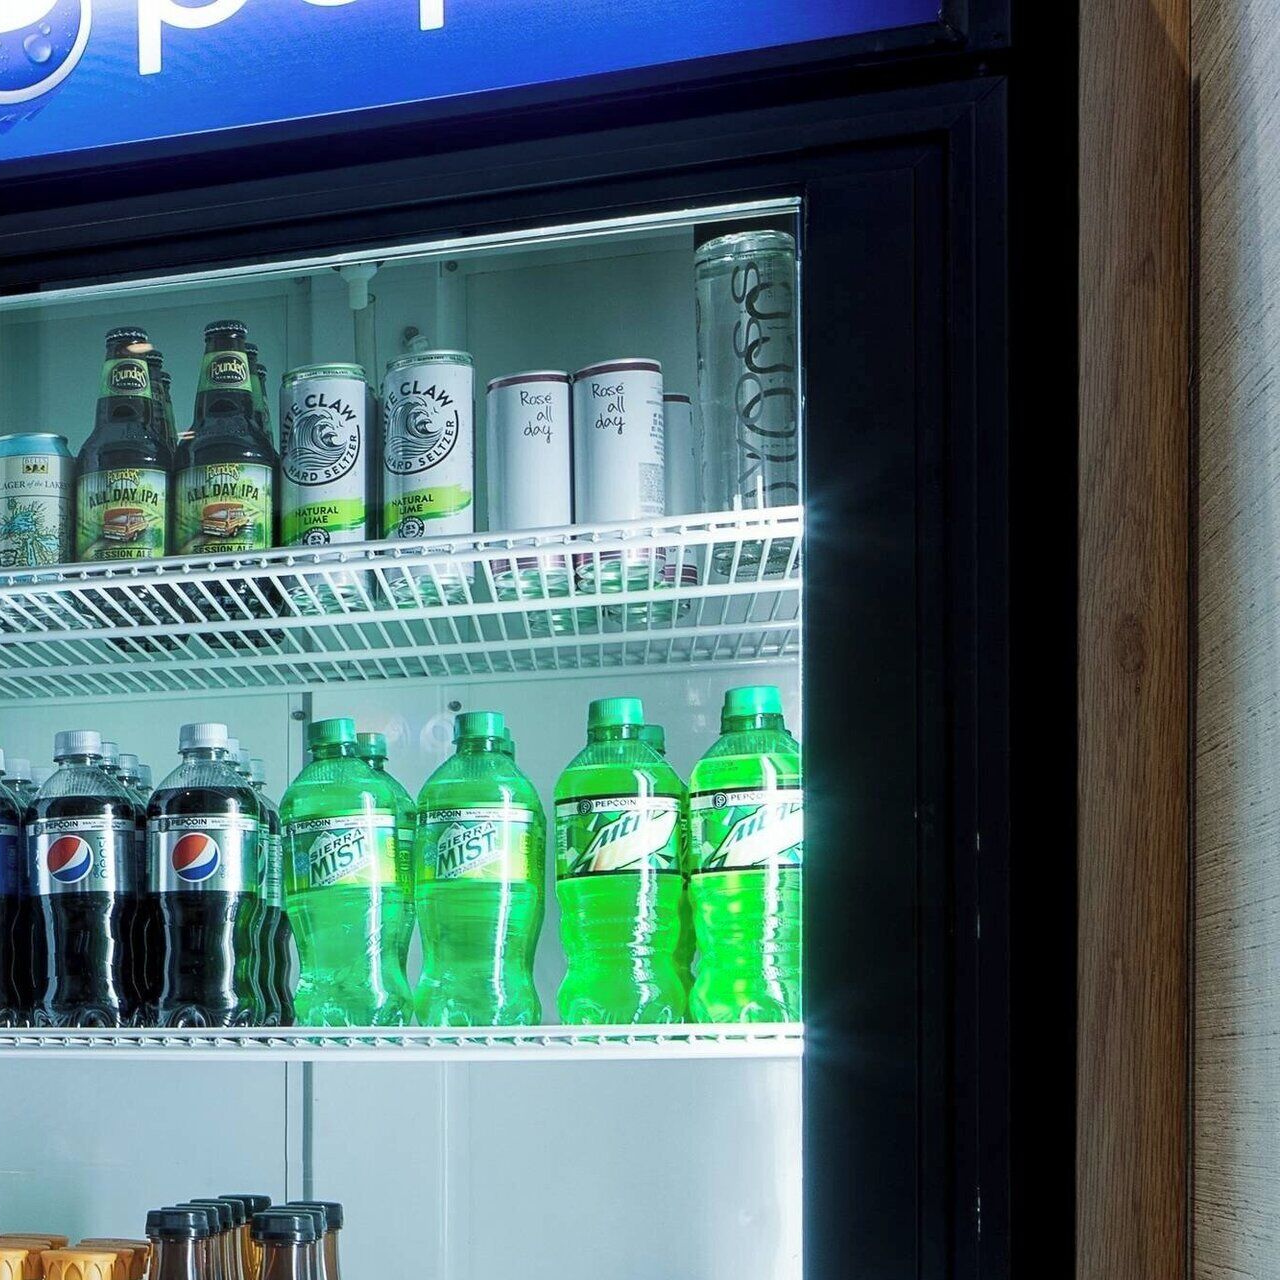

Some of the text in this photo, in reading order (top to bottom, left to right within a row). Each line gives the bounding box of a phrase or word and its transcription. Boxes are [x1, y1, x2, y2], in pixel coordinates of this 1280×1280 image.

[400, 381, 453, 407] CLAW
[520, 390, 552, 406] Rosé
[592, 382, 625, 399] Rosé
[304, 393, 357, 422] CLAW
[607, 395, 626, 414] all
[536, 406, 553, 423] all
[523, 422, 553, 443] day
[595, 414, 626, 435] day
[387, 420, 454, 471] HARD SELTZER
[288, 434, 357, 482] HARD SELTZER
[89, 488, 158, 510] ALL DAY IPA
[187, 483, 259, 504] ALL DAY IPA
[392, 494, 434, 507] NATURAL
[295, 506, 338, 517] NATURAL
[400, 504, 423, 515] LIME
[304, 516, 328, 526] LIME
[94, 549, 152, 558] SESSION ALE
[237, 545, 253, 553] ALE
[171, 818, 207, 828] PEPCOIN
[428, 810, 461, 820] PEPCOIN
[45, 820, 79, 830] PEPCOIN
[296, 819, 331, 830] PEPCOIN
[309, 828, 362, 862] SIERRA
[439, 822, 493, 851] SIERRA
[311, 836, 365, 886] MIST
[438, 829, 496, 878] MIST
